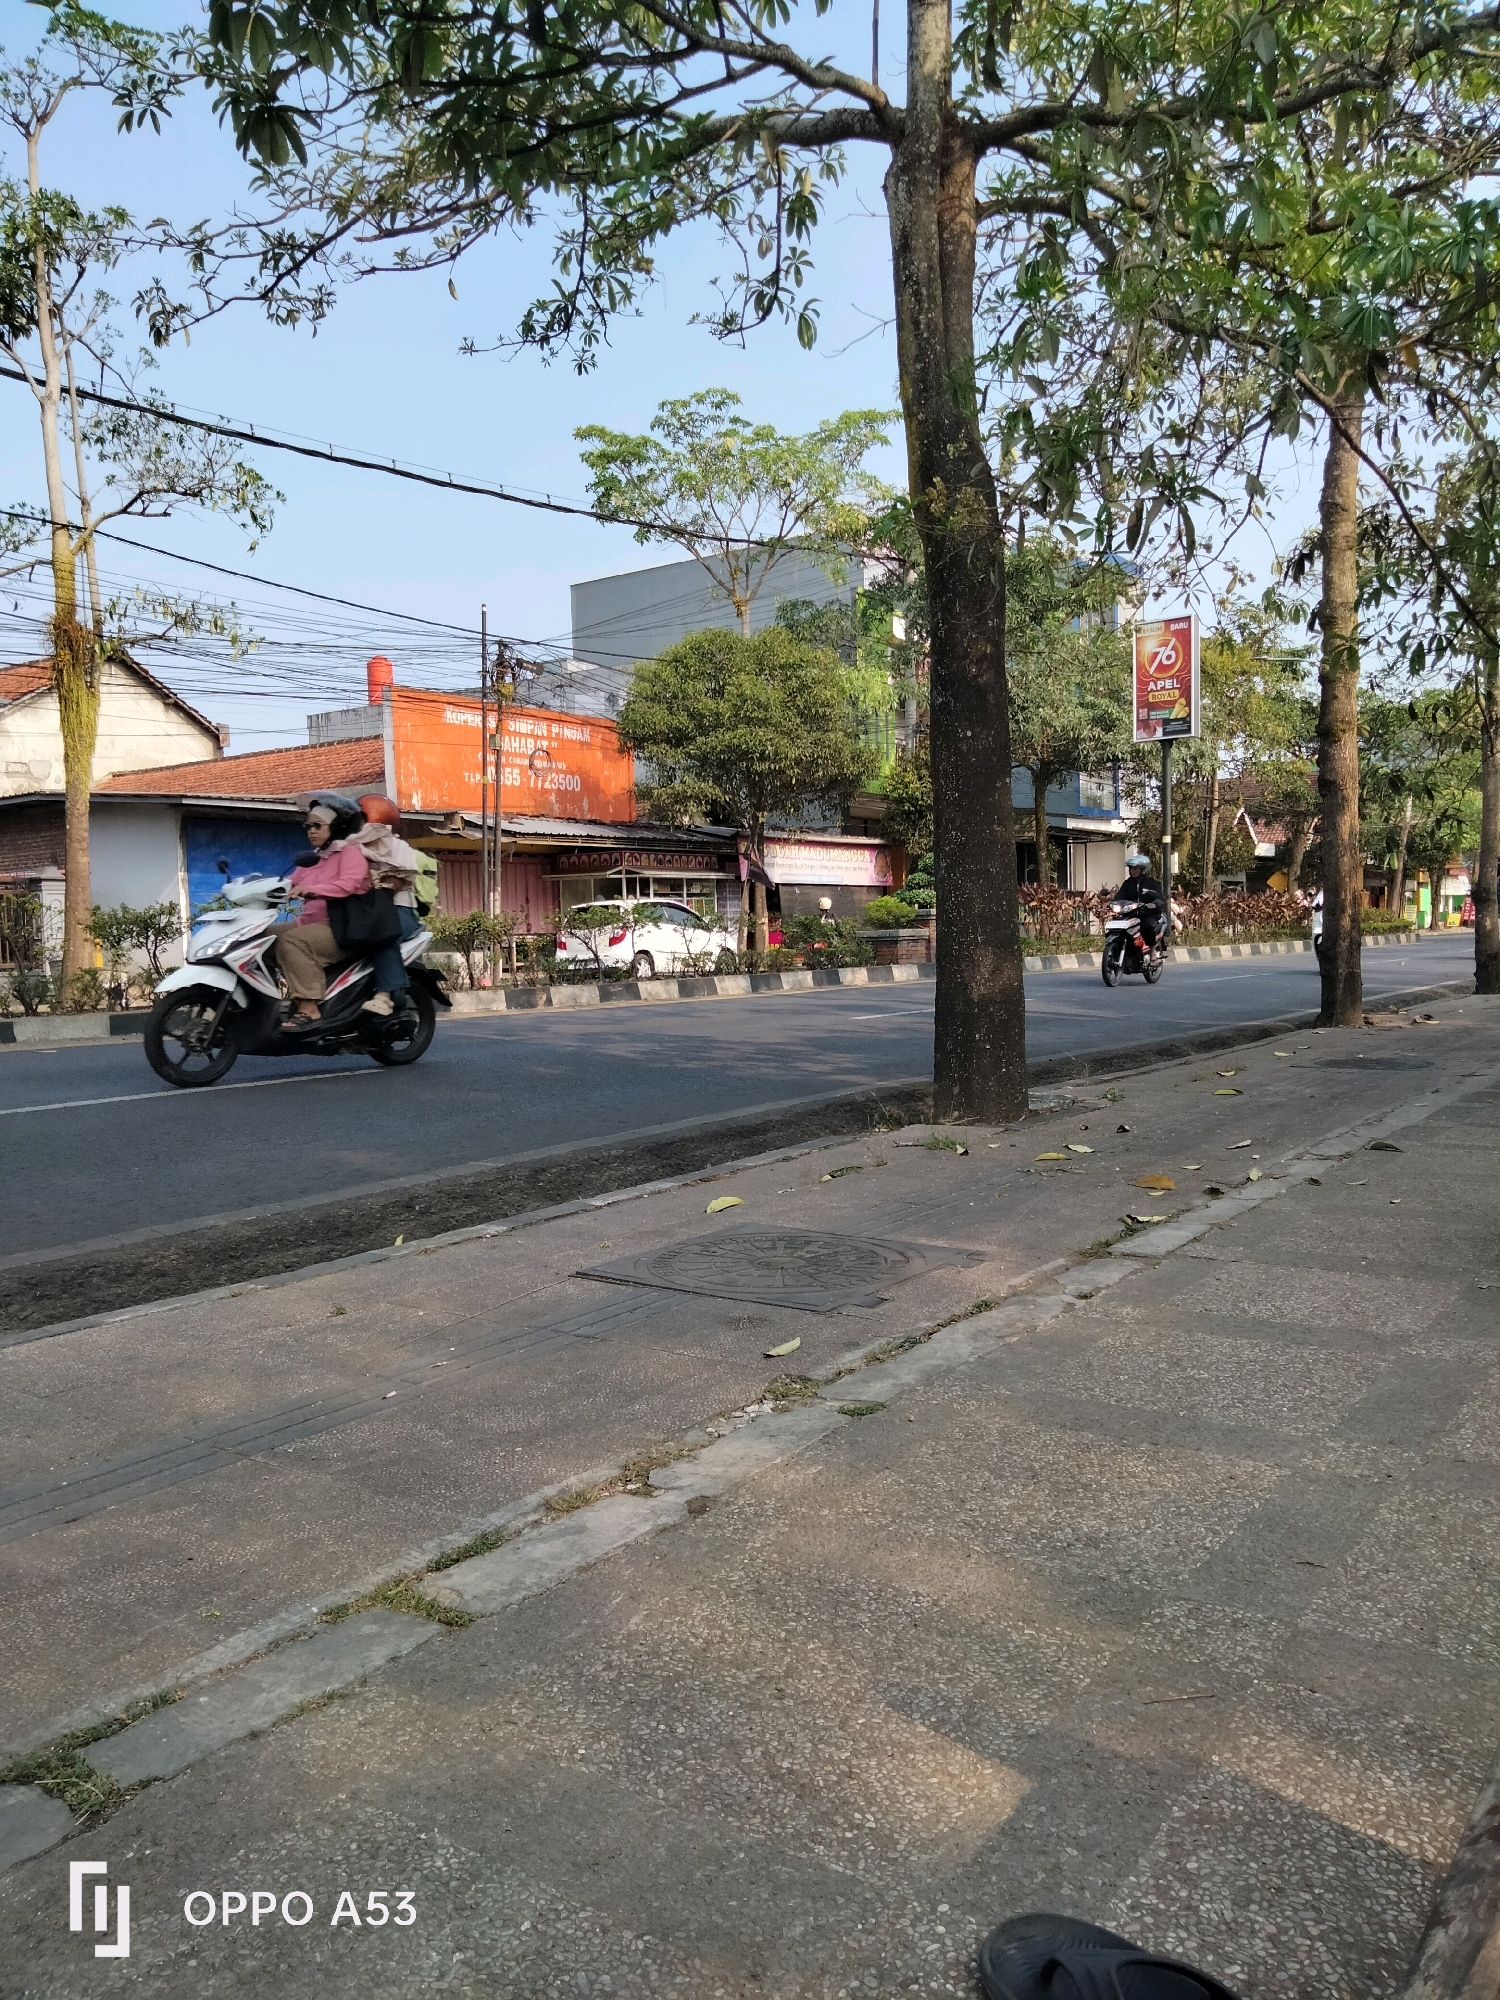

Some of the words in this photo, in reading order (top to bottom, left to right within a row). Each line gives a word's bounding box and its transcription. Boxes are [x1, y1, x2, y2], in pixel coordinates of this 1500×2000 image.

[1170, 622, 1189, 631] BARU
[1149, 637, 1177, 675] 76
[1147, 679, 1181, 691] APEL
[1151, 691, 1177, 701] ROYAL
[446, 709, 498, 729] KOPERS
[508, 718, 547, 737] SIMPAN
[551, 723, 591, 743] PINJAM
